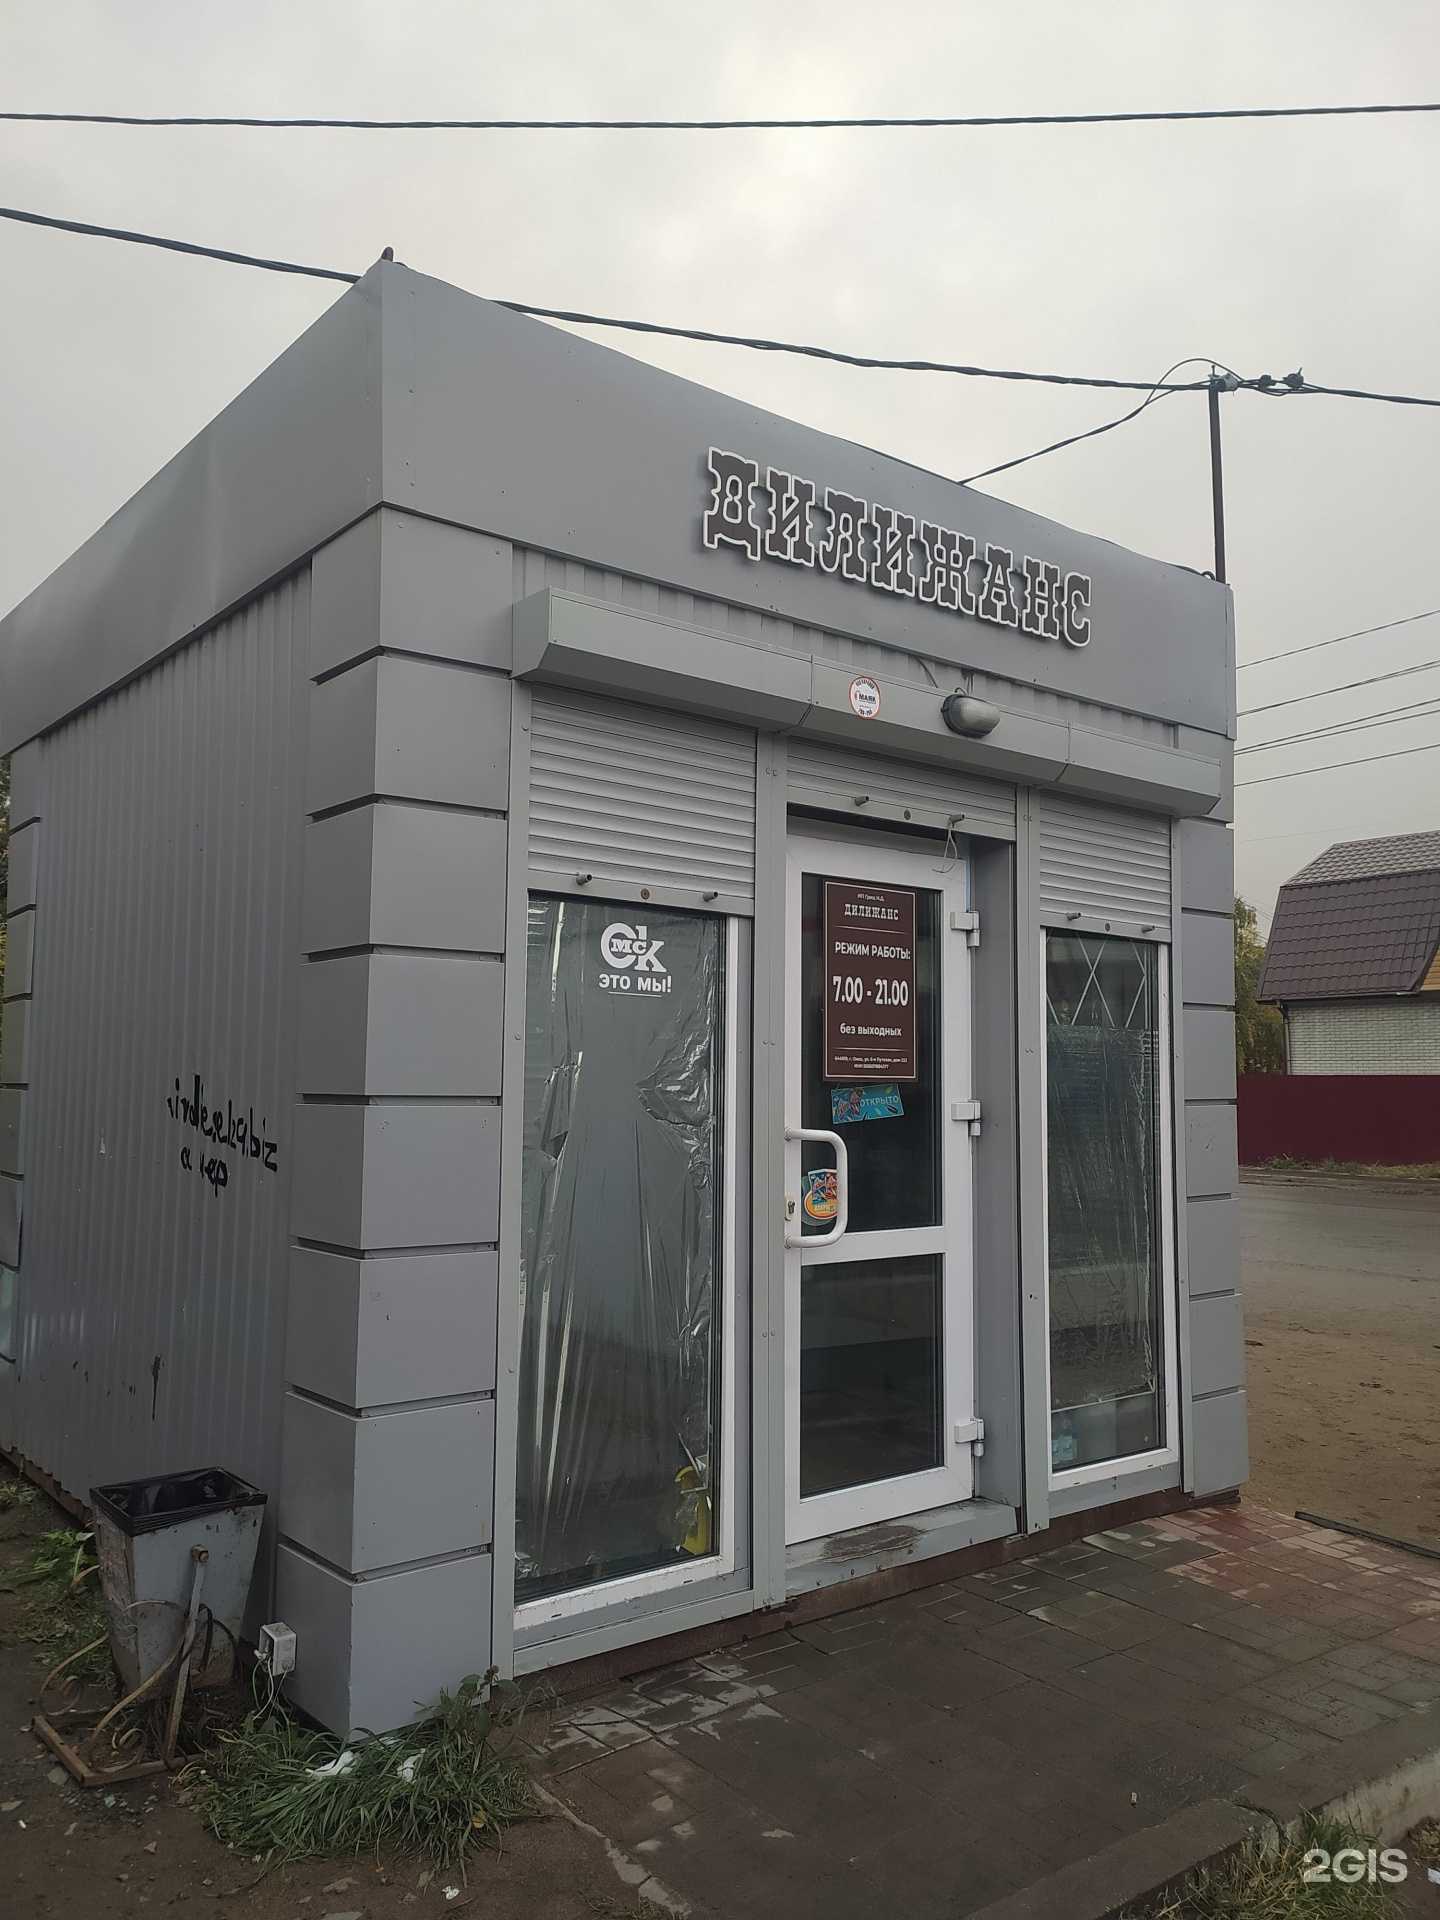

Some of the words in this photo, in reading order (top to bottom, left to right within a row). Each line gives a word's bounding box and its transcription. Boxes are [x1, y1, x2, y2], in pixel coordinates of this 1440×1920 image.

[703, 446, 1092, 648] ДИЛИЖАНС
[844, 903, 899, 921] ДИЛИЖАНС
[834, 941, 870, 956] РЕЖИМ
[871, 944, 911, 960] РАБОТЫ:
[598, 973, 631, 989] ЭТО
[637, 975, 672, 993] МЫ!
[832, 975, 863, 1004] 7.00
[874, 978, 909, 1007] 21.00
[840, 1022, 855, 1034] без
[857, 1025, 902, 1037] выходных
[859, 1095, 899, 1107] ОТКРЫТО
